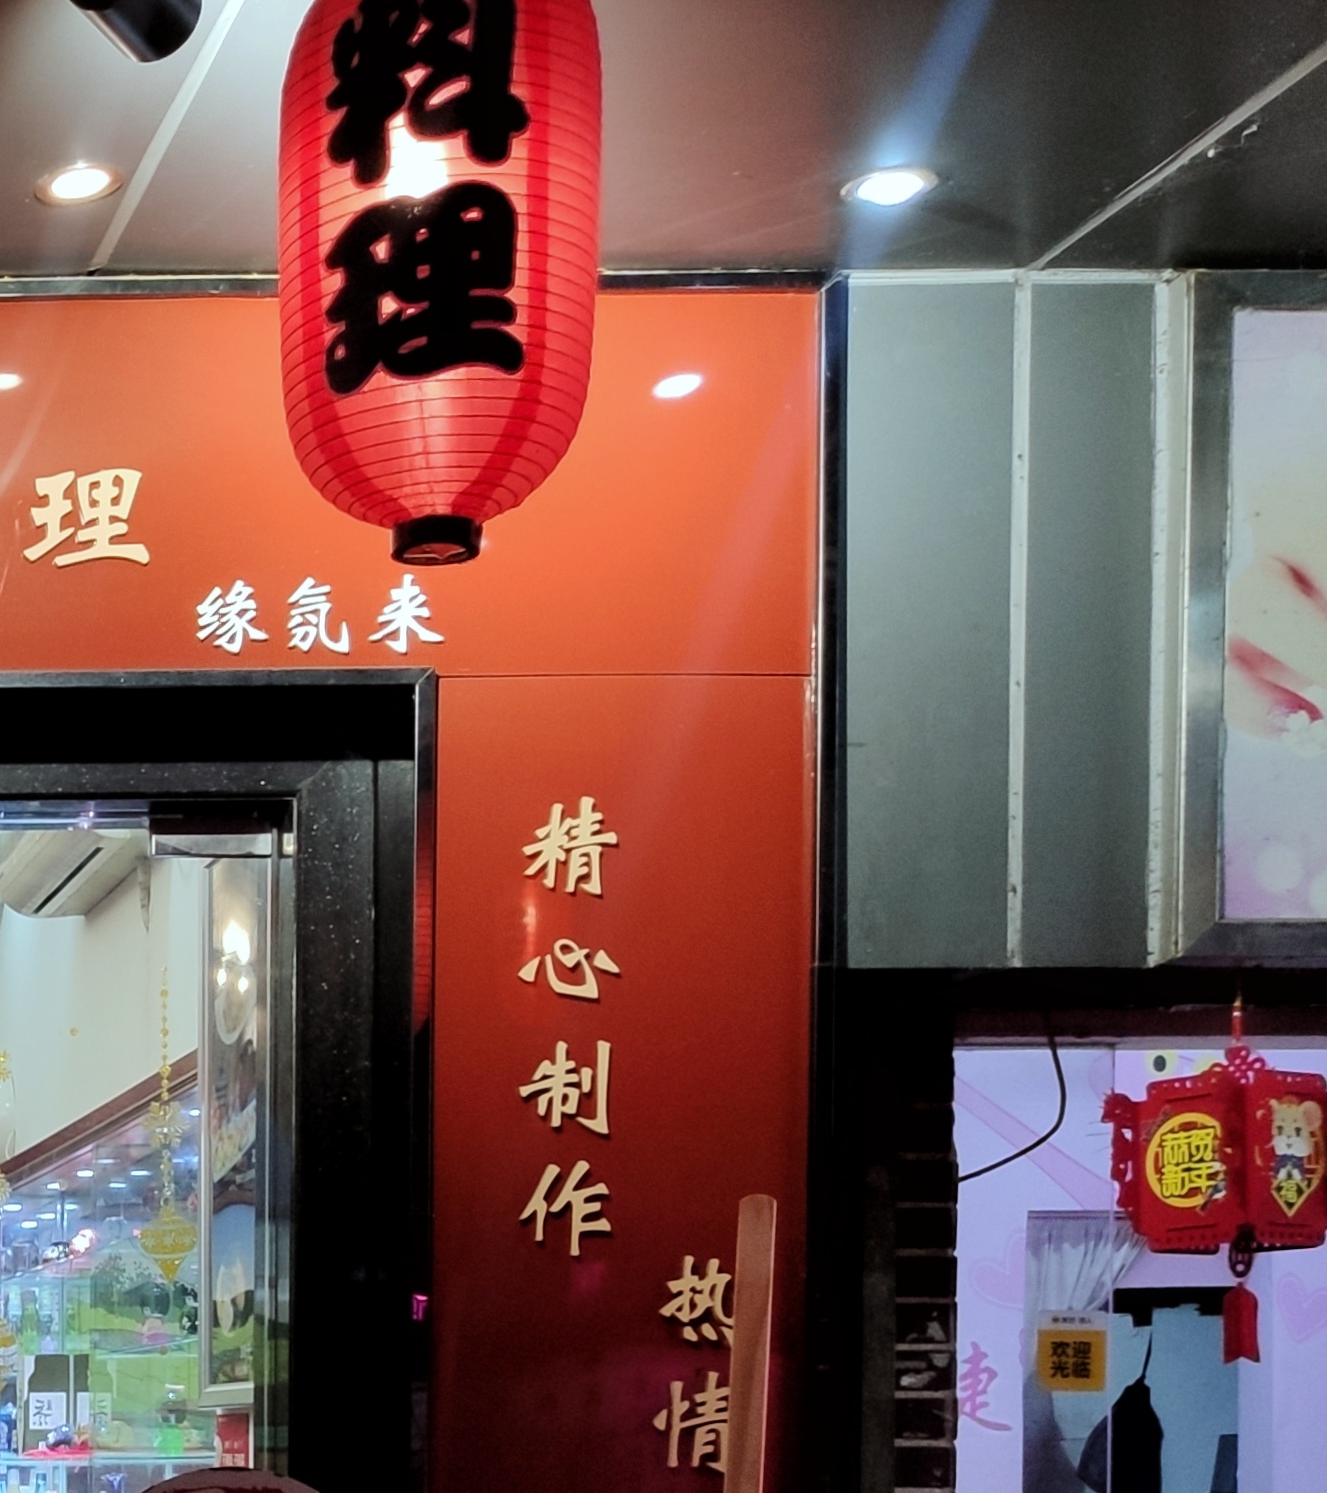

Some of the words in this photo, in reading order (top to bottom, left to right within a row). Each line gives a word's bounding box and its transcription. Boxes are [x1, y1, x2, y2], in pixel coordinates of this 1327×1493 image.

[323, 0, 531, 396] 料理
[517, 796, 621, 1257] 精心制作
[1050, 1340, 1092, 1360] 欢迎
[1050, 1360, 1092, 1379] 光临
